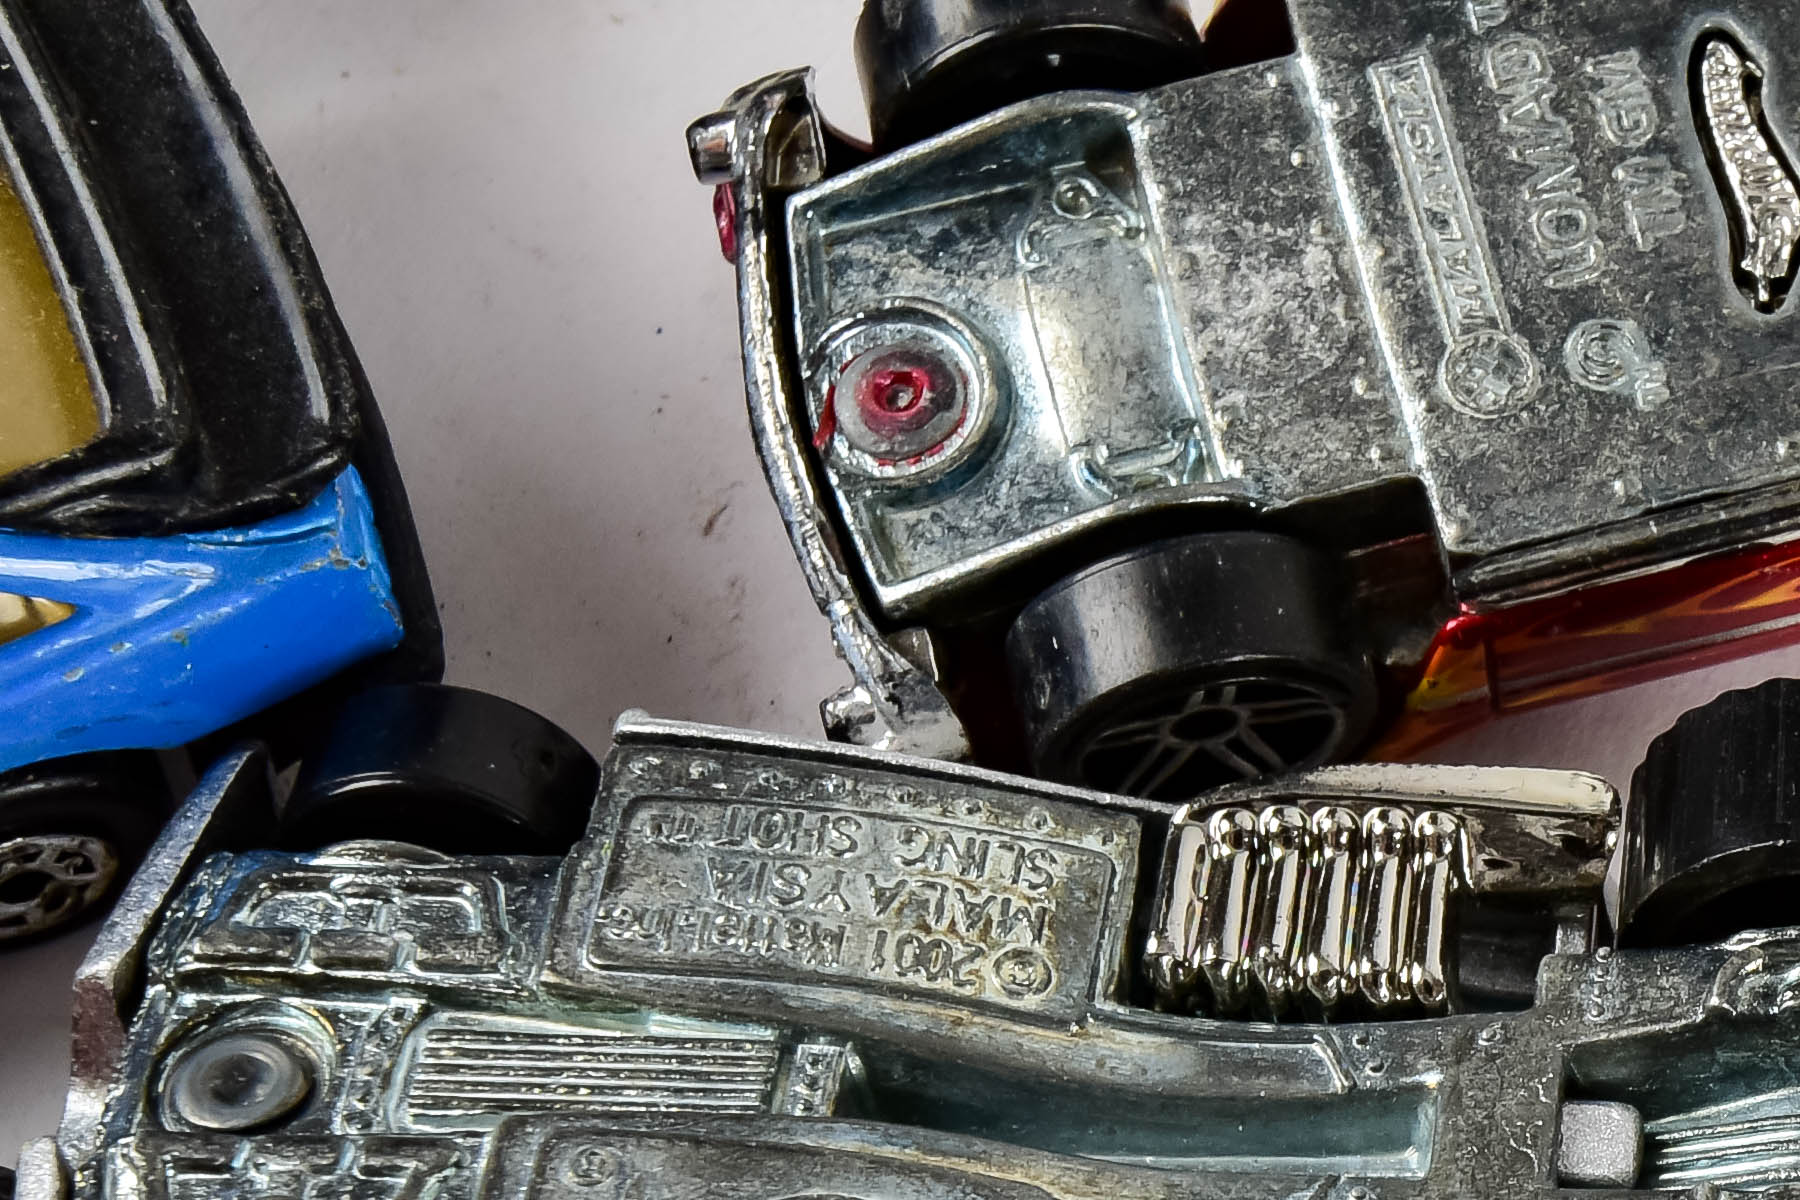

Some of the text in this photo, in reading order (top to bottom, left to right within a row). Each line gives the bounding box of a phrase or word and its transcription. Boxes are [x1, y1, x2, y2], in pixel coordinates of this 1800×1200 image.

[1389, 65, 1495, 325] MALAYSIA
[709, 803, 862, 860] SHOT
[898, 825, 1058, 892] SLING
[706, 858, 1052, 946] MALAYSIA
